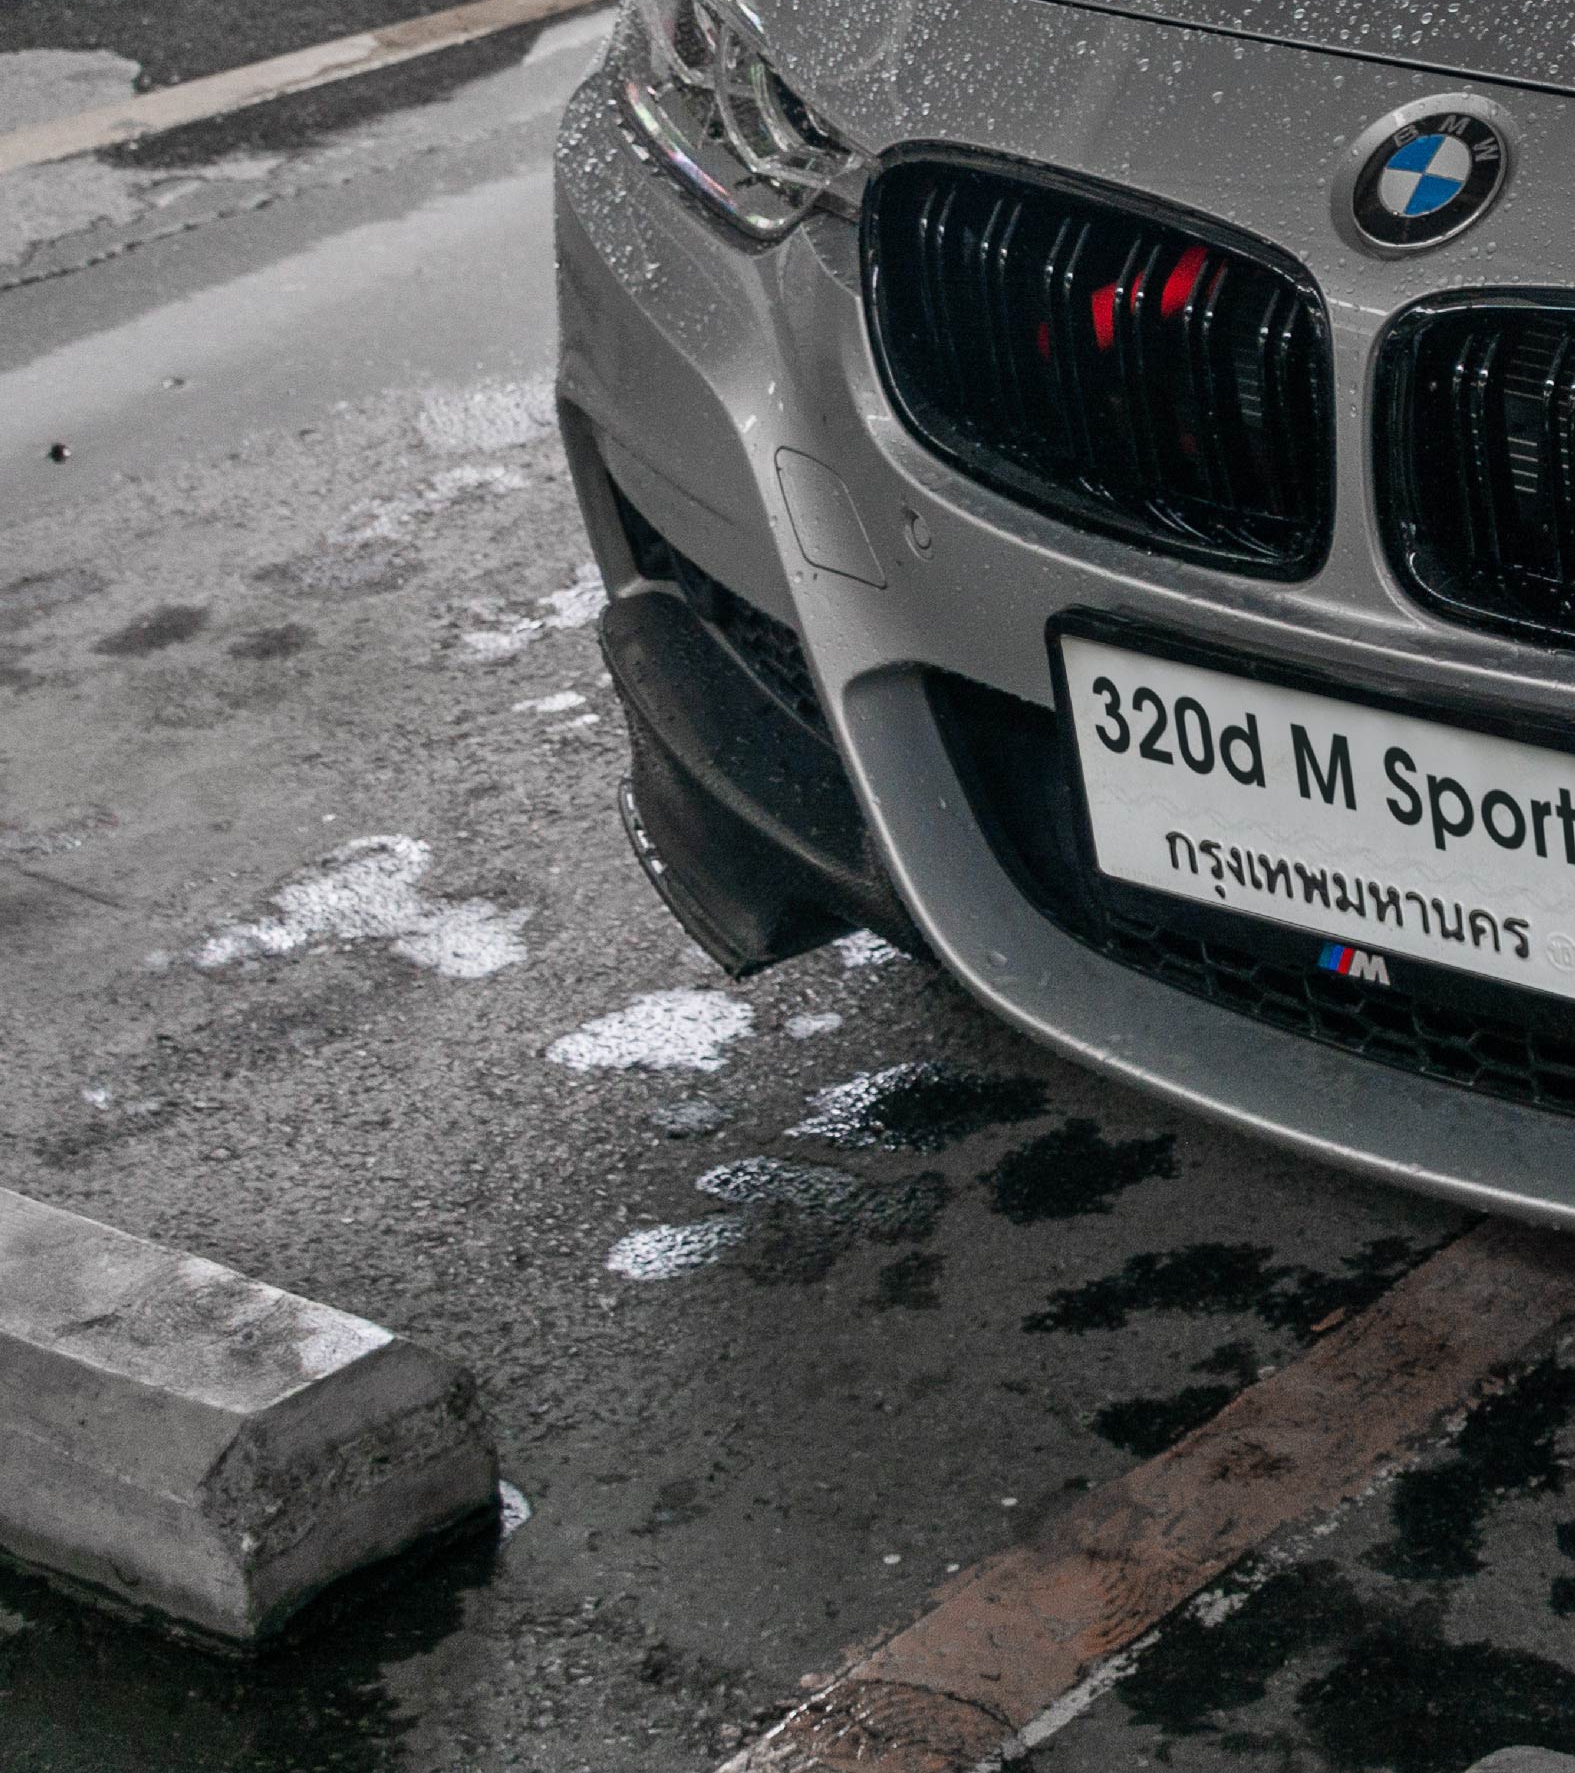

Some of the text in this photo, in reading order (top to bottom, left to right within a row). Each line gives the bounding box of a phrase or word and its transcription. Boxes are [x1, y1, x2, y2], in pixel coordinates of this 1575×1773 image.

[1393, 114, 1500, 163] BMW
[1092, 676, 1266, 788] 320d
[1290, 723, 1357, 811] M
[1165, 830, 1530, 960] กรุงเทพมหานคร
